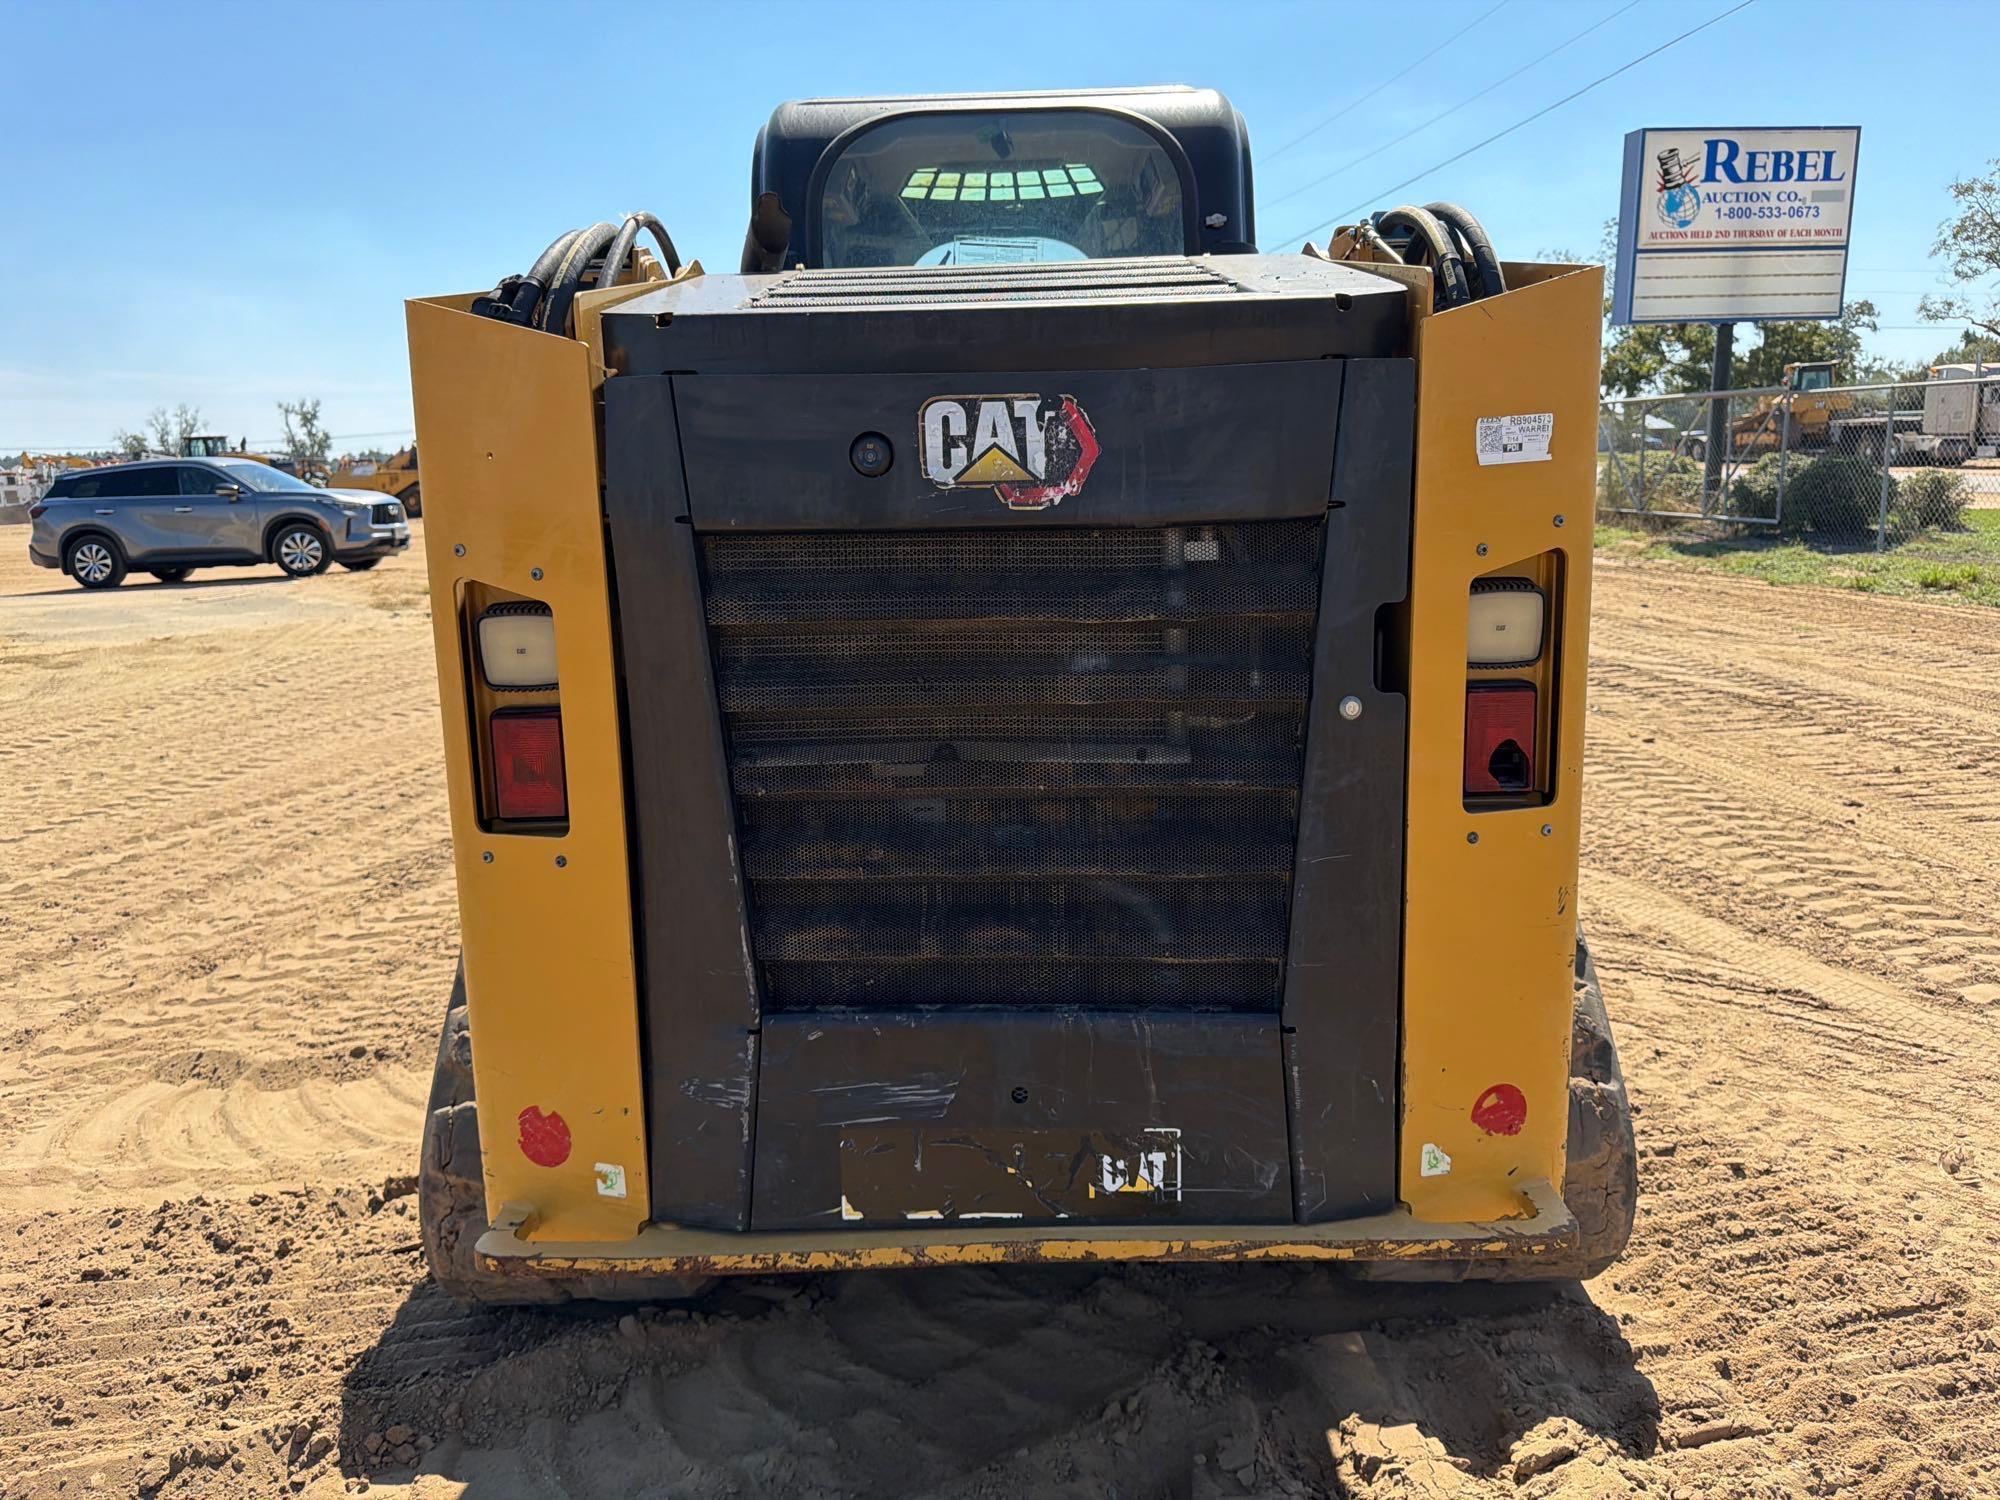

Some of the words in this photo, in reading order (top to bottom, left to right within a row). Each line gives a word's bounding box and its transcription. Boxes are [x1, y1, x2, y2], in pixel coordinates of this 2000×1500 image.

[1700, 138, 1846, 184] REBEL
[1702, 191, 1771, 204] AUCTION
[1715, 206, 1820, 220] 1-800-533-0673
[1649, 231, 1688, 240] AUCTIONS
[1690, 230, 1712, 239] HELD
[1714, 230, 1731, 239] 2ND
[1733, 229, 1776, 238] THURSDAY
[1778, 229, 1788, 238] OF
[1790, 229, 1812, 237] EACH
[1814, 228, 1842, 237] MONTH
[1510, 415, 1552, 426] RB904573
[924, 400, 1050, 485] CAT
